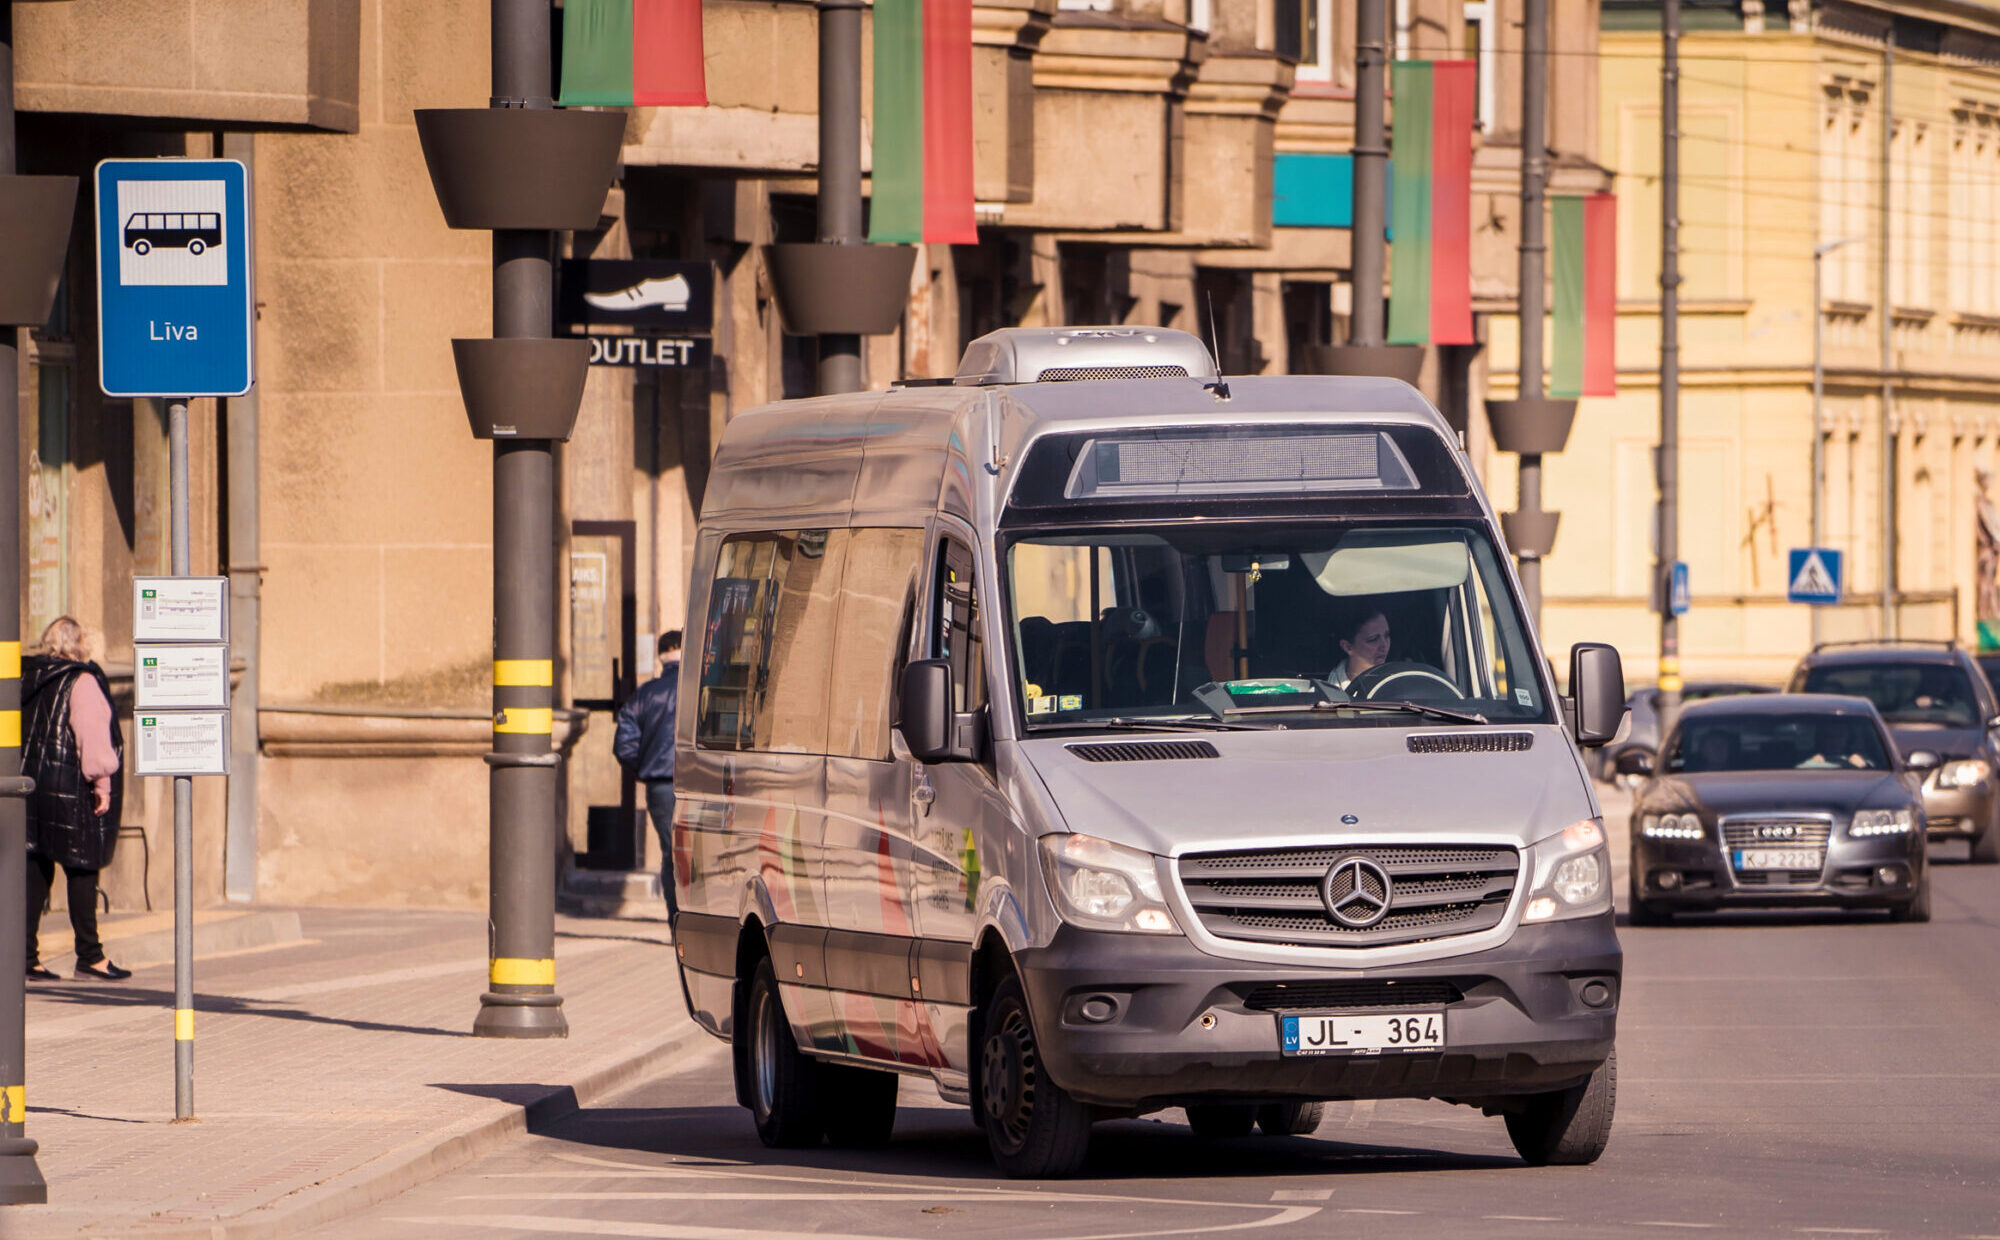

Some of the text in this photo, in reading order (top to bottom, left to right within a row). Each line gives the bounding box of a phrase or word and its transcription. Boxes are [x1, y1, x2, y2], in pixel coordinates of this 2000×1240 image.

[149, 320, 198, 341] Līva
[1285, 1036, 1298, 1045] LV
[1387, 1017, 1439, 1044] 364
